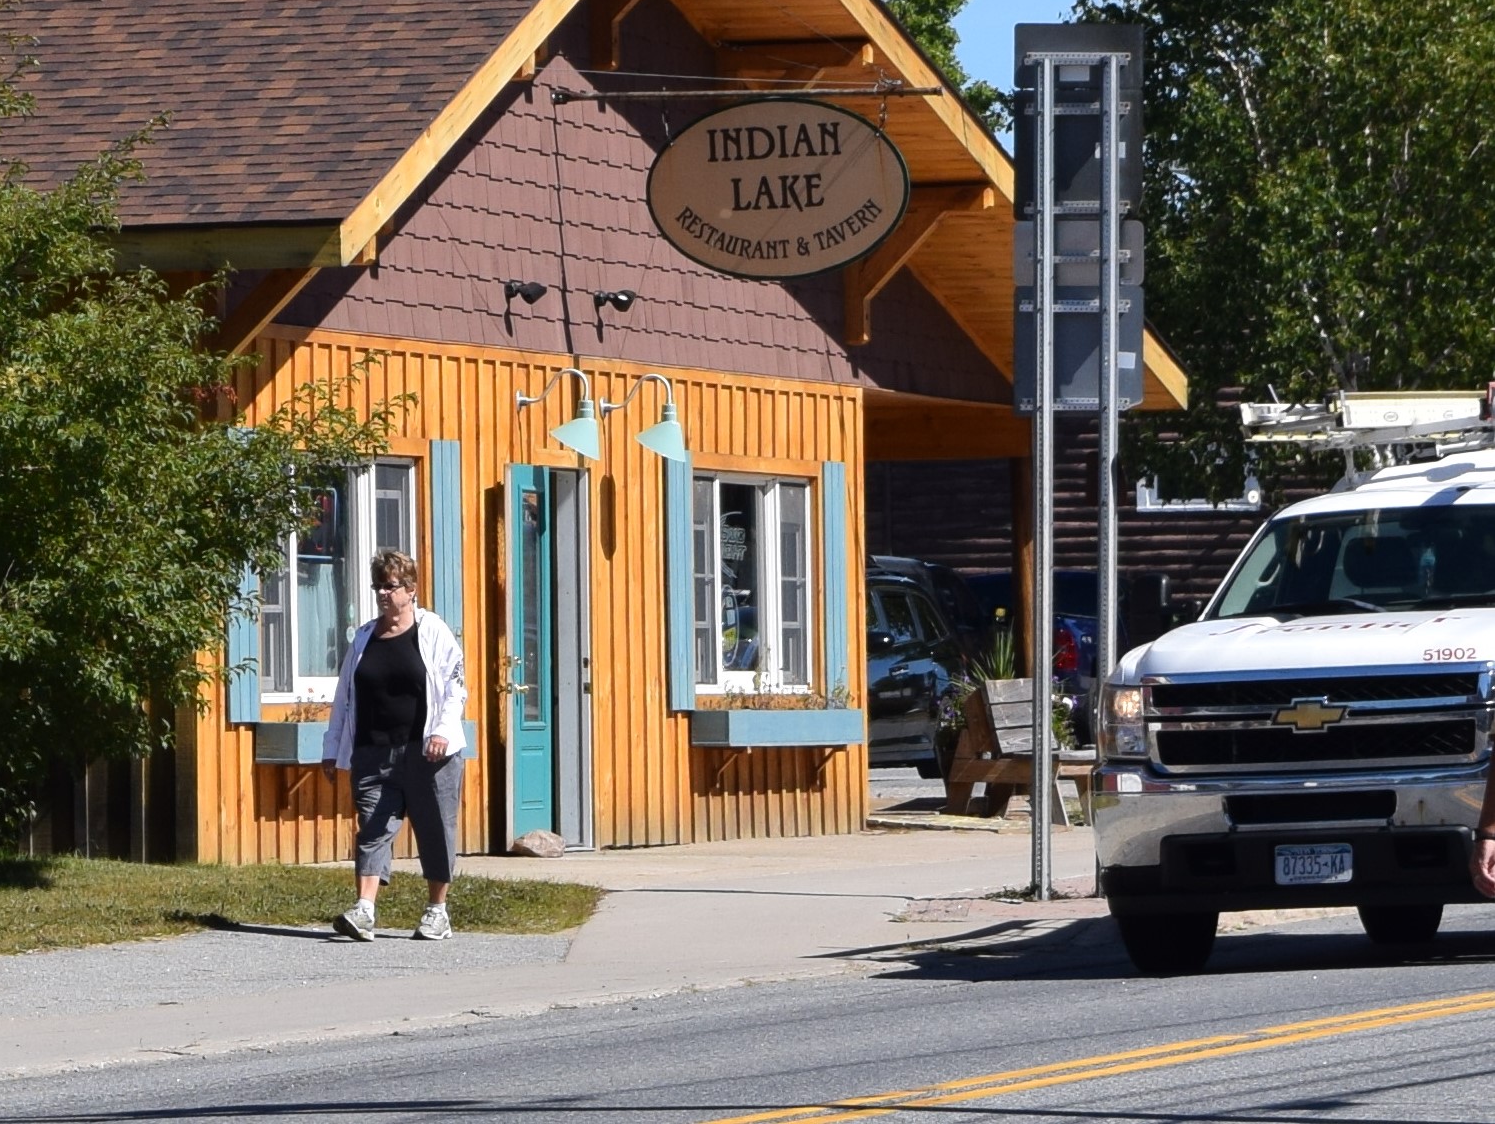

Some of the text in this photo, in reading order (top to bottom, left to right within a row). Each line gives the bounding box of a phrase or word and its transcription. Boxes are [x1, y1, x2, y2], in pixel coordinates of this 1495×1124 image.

[707, 122, 842, 163] INDIAN
[731, 173, 825, 212] LAKE
[675, 198, 883, 261] RESTAURANT & TAVERN
[1423, 647, 1477, 662] 51902
